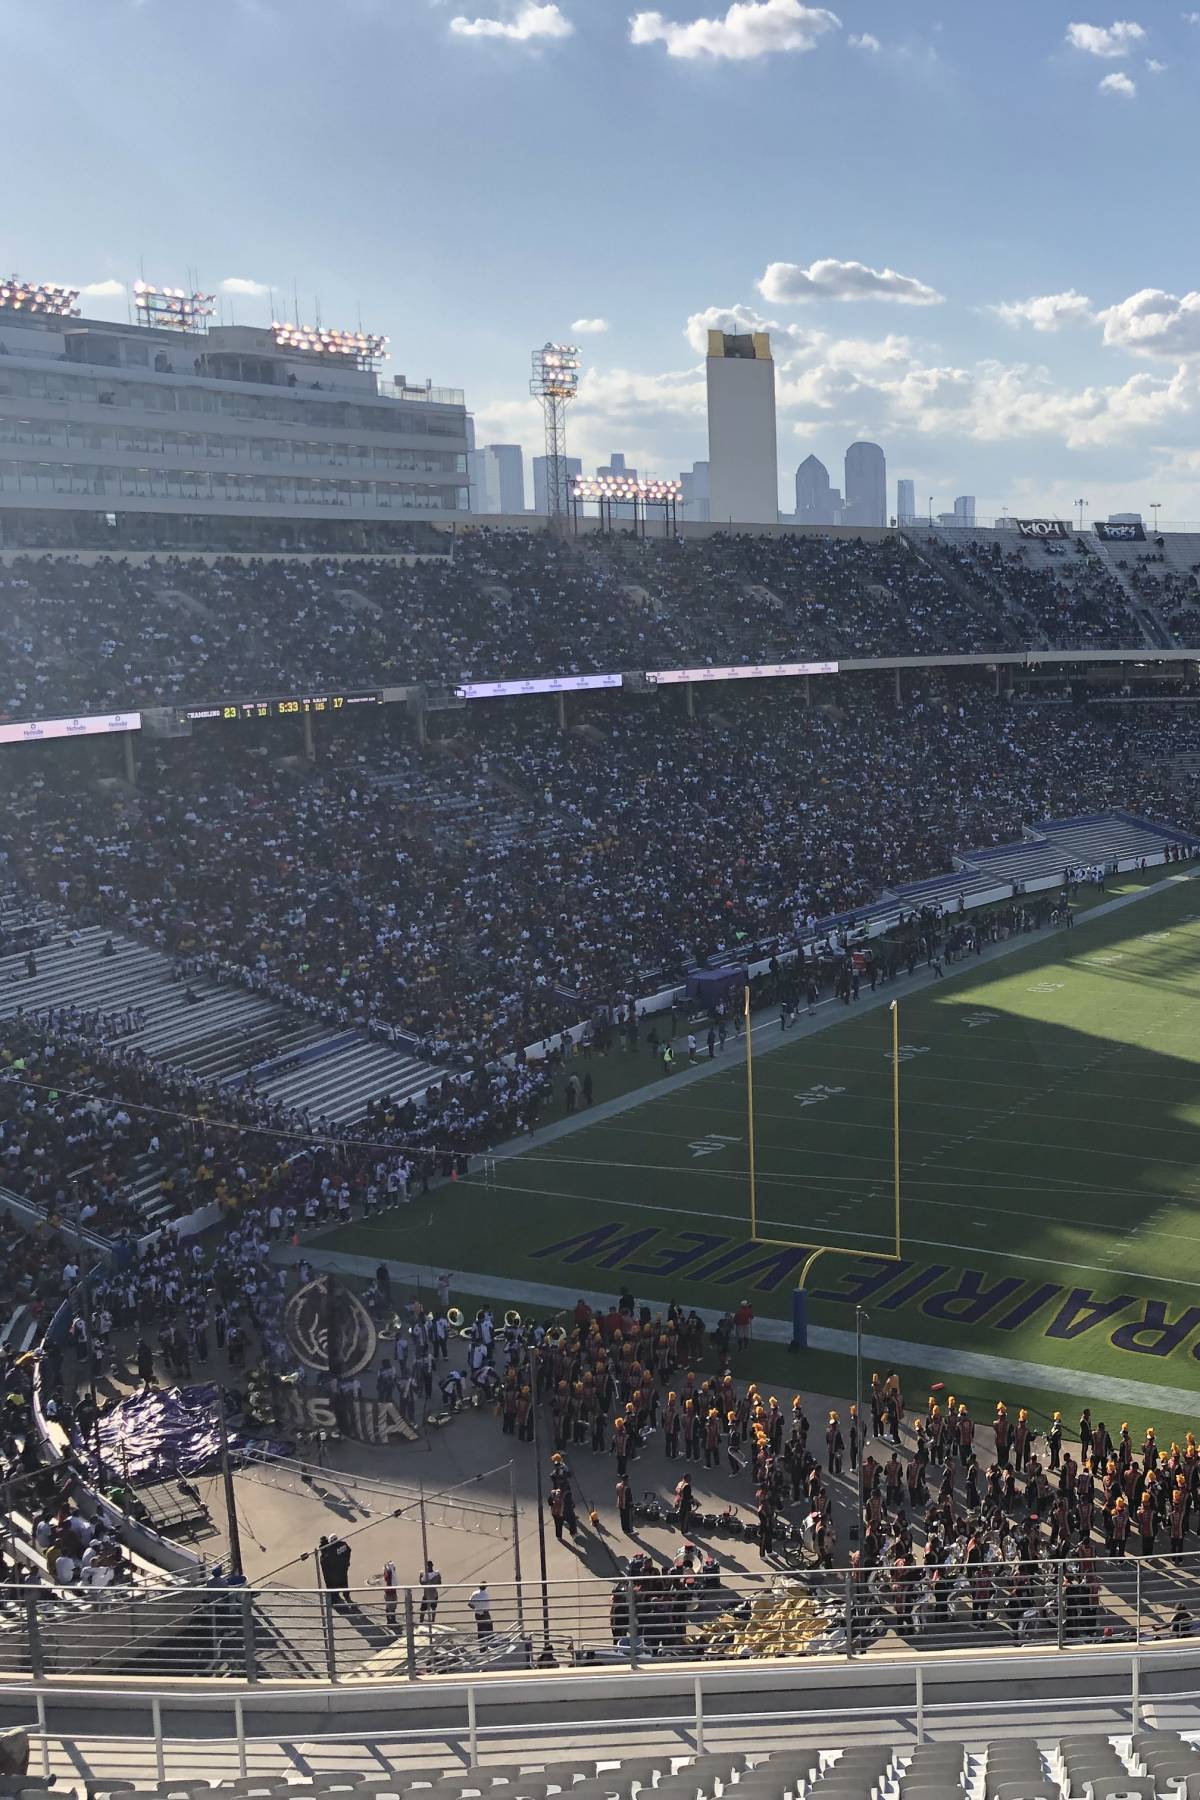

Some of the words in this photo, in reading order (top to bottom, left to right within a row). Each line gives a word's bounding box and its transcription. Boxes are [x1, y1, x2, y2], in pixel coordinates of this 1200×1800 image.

[279, 701, 299, 713] 5:33
[332, 698, 343, 708] 17
[223, 707, 237, 719] 23
[526, 1221, 812, 1294] VIEW
